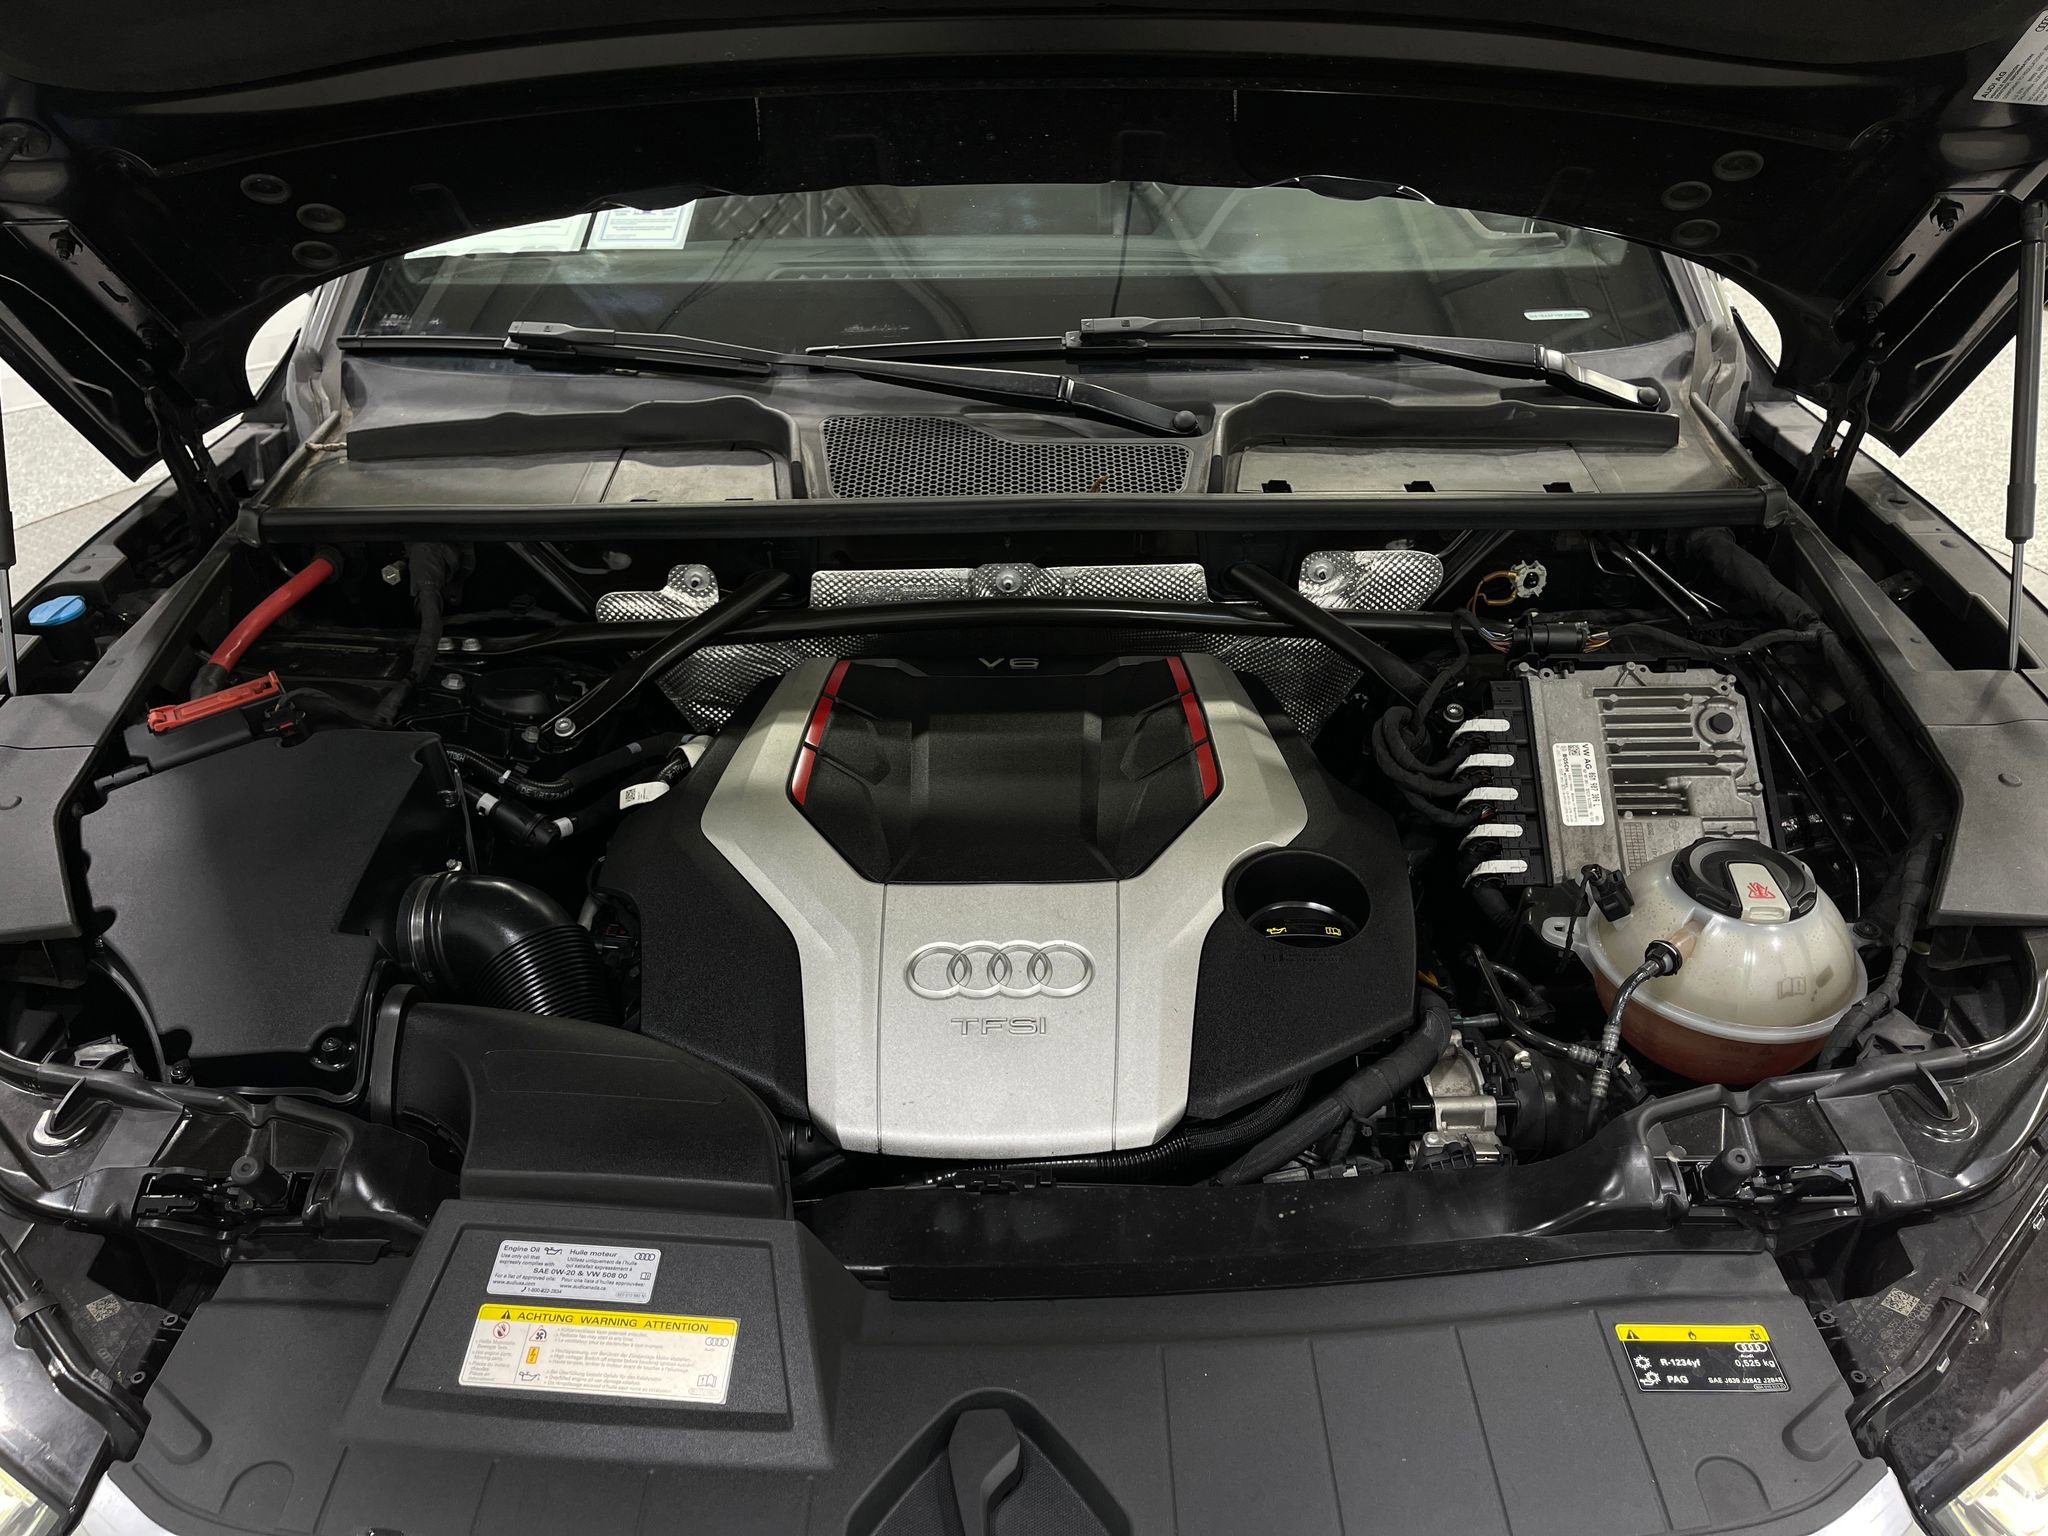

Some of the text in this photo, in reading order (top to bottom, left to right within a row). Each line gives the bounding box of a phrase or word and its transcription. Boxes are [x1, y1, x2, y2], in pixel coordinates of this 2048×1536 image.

[1981, 72, 2007, 98] AUDI AG
[977, 657, 1040, 670] V6
[1583, 744, 1590, 756] VW
[1585, 759, 1592, 770] AG
[949, 1015, 1048, 1036] TFSI
[504, 1245, 528, 1253] Engine
[517, 1311, 709, 1332] ACHTUNG WARNING ATTENTION
[1660, 1358, 1701, 1368] R-1234yf
[1734, 1359, 1775, 1368] 0,525 kg
[1666, 1375, 1689, 1384] PAG
